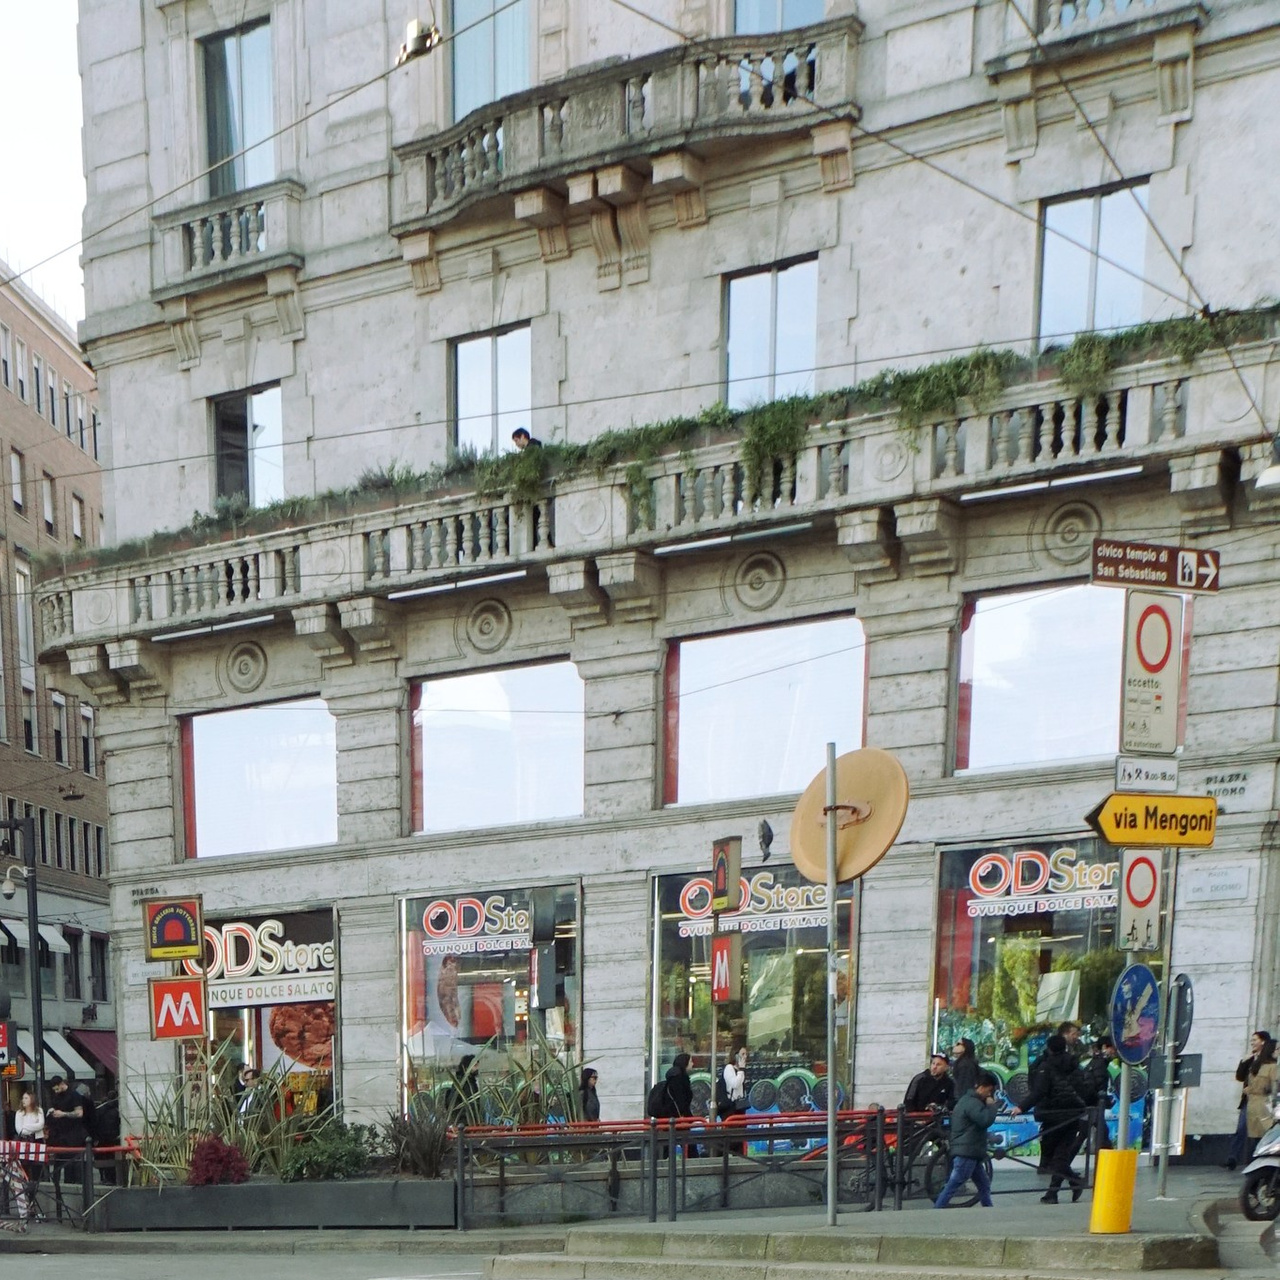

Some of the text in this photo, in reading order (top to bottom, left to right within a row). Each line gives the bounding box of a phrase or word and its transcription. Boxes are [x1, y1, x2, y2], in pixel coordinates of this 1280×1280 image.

[1097, 544, 1123, 558] civico
[1159, 550, 1168, 563] di
[1097, 563, 1167, 582] San Sebastiano
[1114, 806, 1213, 836] via Mengoni
[969, 848, 1119, 899] ODStor
[969, 895, 1118, 917] OVUNQUE DOLCE SALA
[422, 895, 529, 939] ODSto
[741, 919, 780, 933] DOLCE
[783, 915, 828, 929] SALATO
[423, 942, 475, 955] OVUNQUE
[477, 939, 511, 952] DOLCE
[247, 985, 284, 999] DOLCE
[287, 981, 334, 996] SALATO
[157, 991, 199, 1028] M
